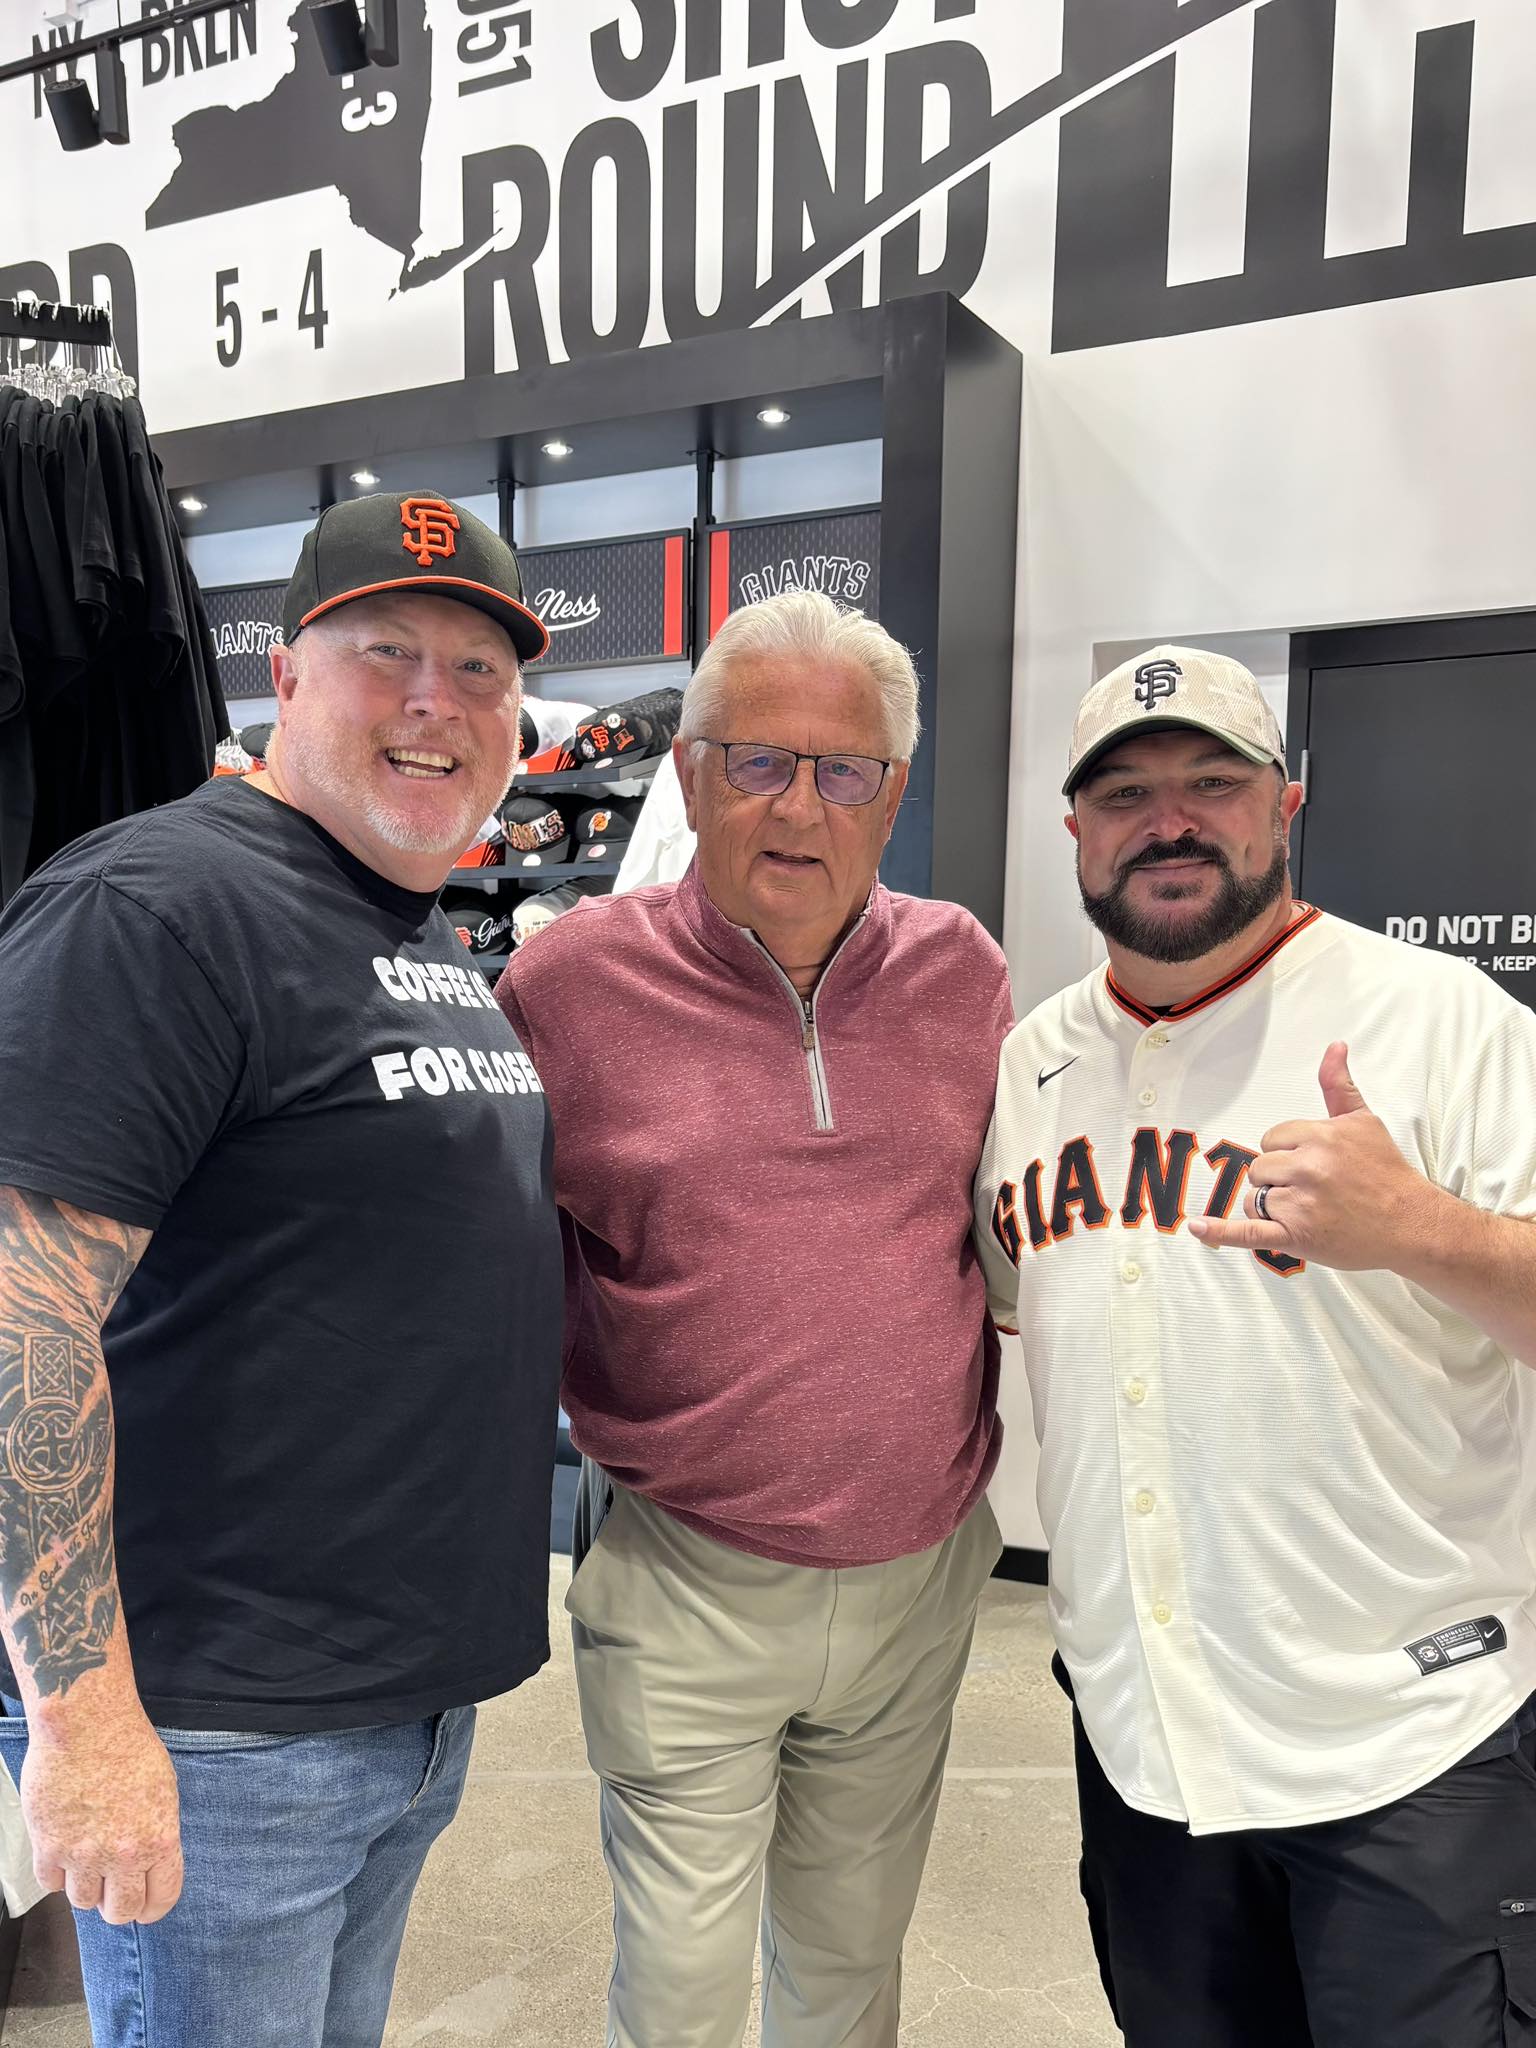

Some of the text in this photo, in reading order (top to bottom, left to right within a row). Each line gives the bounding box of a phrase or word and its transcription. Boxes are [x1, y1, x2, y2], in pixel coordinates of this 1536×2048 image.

[462, 40, 992, 381] ROUND
[216, 267, 242, 368] 5
[298, 248, 329, 350] 4
[739, 556, 871, 607] GIANTS
[534, 587, 601, 632] Ness
[210, 621, 285, 659] ANTS
[1386, 915, 1428, 945] DO
[1437, 914, 1503, 945] NOT
[373, 956, 483, 1008] COFFEE
[1492, 955, 1536, 972] KEEP
[371, 1046, 544, 1101] FOR CLOSE
[991, 1127, 1306, 1278] GIANT
